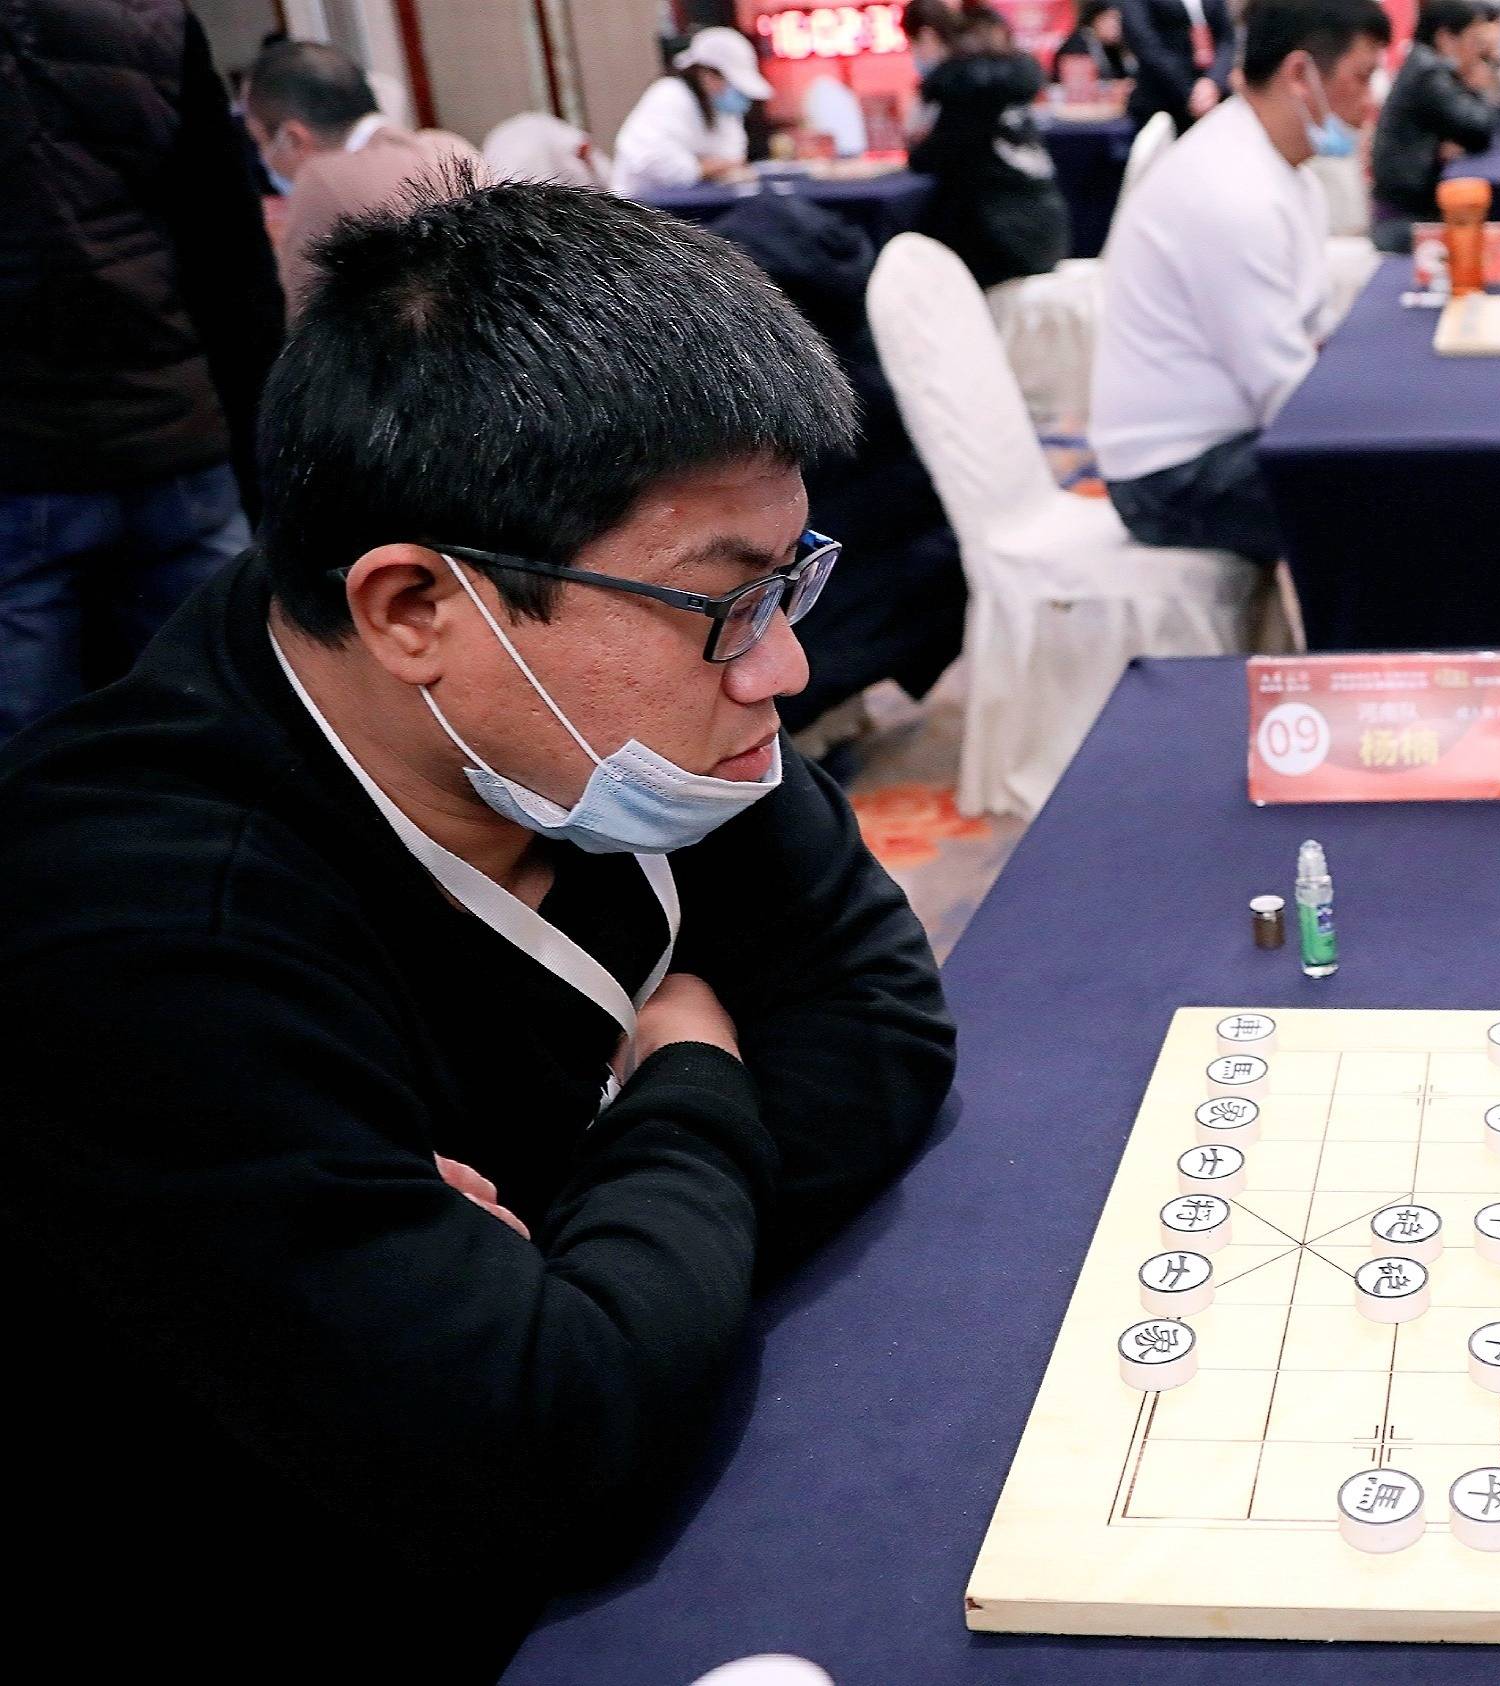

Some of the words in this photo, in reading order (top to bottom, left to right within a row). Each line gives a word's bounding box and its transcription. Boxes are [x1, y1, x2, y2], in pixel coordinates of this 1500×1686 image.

[1266, 714, 1321, 757] 09
[1230, 1017, 1264, 1038] 車
[1221, 1060, 1254, 1079] 馬
[1209, 1101, 1247, 1123] 象
[1197, 1147, 1224, 1175] 士
[1158, 1255, 1190, 1287] 士
[1134, 1325, 1179, 1358] 象
[1355, 1476, 1406, 1513] 馬
